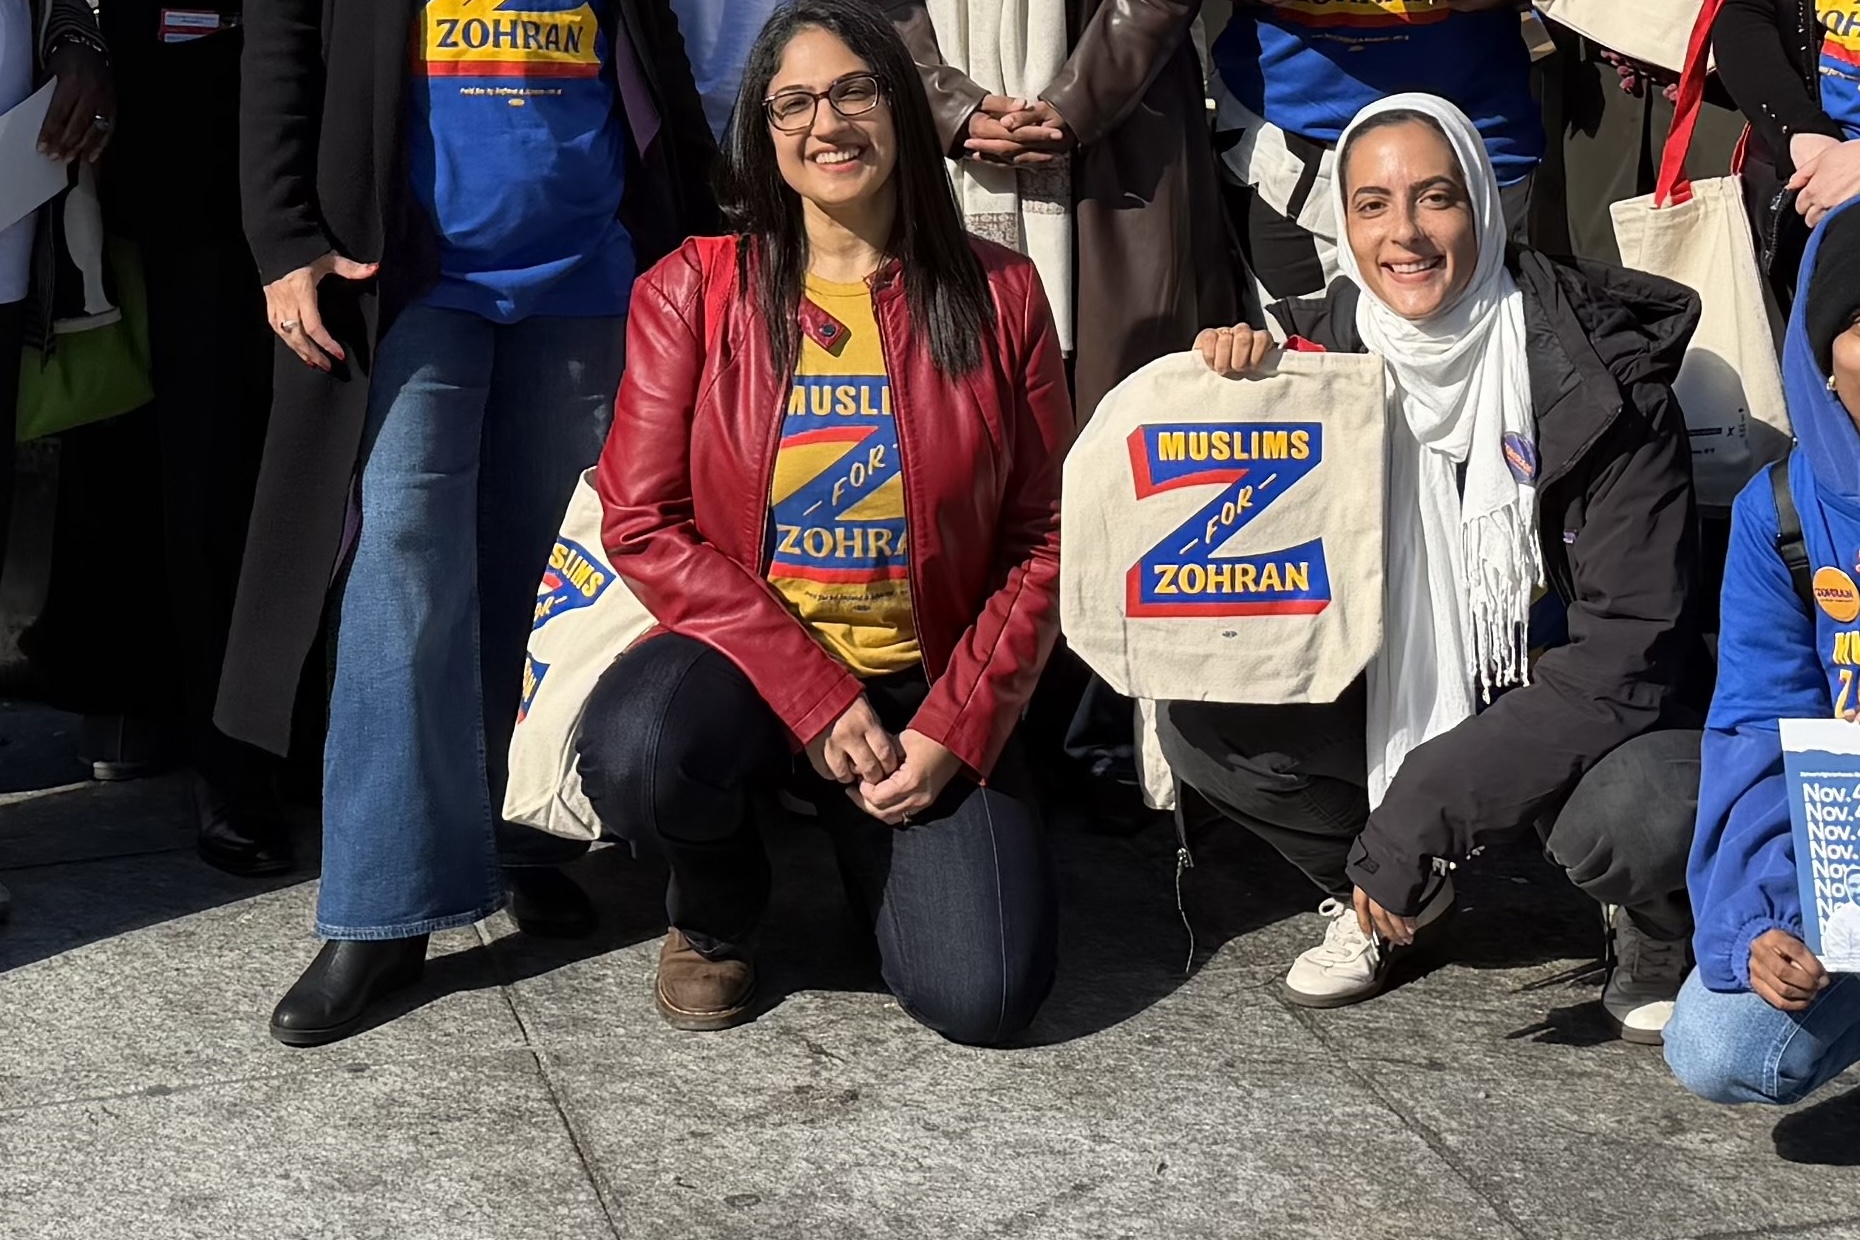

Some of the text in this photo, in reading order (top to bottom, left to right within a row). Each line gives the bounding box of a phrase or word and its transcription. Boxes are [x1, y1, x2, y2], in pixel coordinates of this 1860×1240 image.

[436, 18, 583, 54] ZOHRAN
[788, 385, 892, 416] MUSLI
[1158, 430, 1310, 461] MUSLIMS
[831, 444, 886, 506] FOR
[1205, 485, 1254, 544] FOR
[549, 542, 605, 597] SLIMS
[1153, 562, 1310, 594] ZOHRAN
[1803, 783, 1852, 803] Nov.
[1805, 802, 1854, 822] Nov.
[1807, 821, 1857, 841] Nov.
[1810, 840, 1859, 860] Nov.
